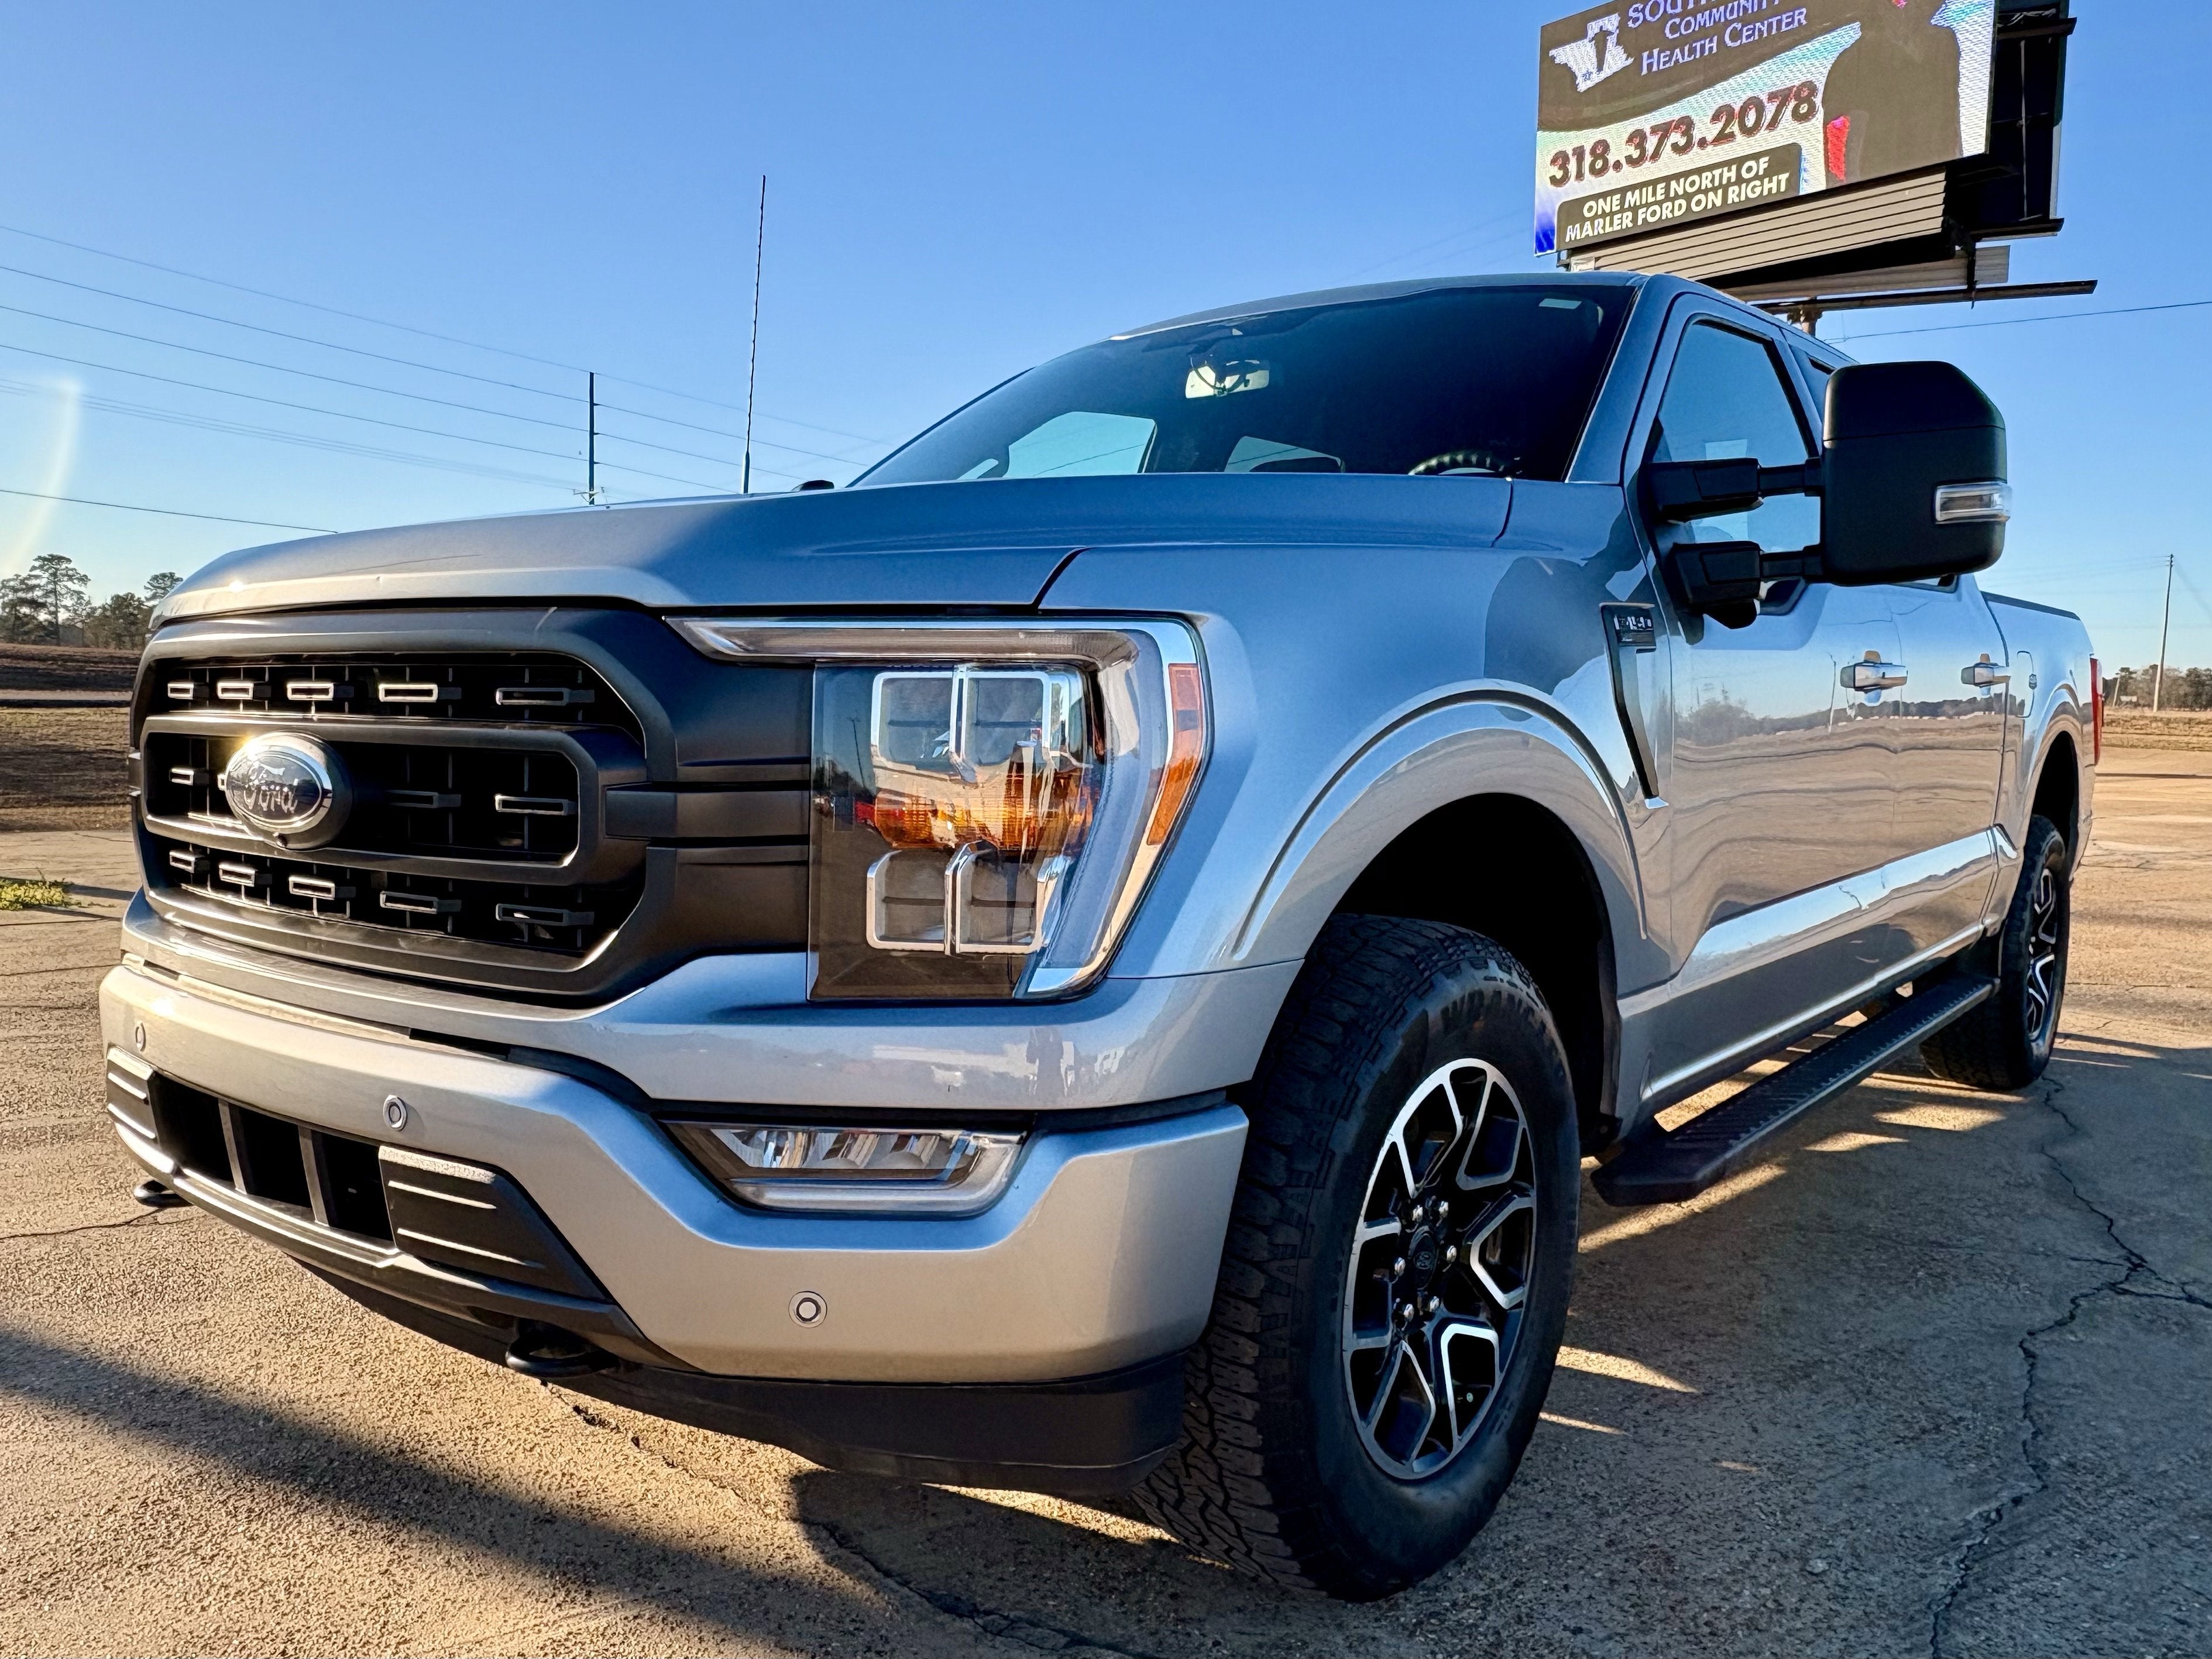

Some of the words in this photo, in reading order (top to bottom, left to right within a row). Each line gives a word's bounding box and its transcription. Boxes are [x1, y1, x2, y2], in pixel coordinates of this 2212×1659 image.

[1628, 0, 1716, 28] SOU
[1640, 35, 1719, 76] HEALTH
[1724, 8, 1808, 48] CENTER
[1549, 81, 1818, 188] 318.373.2078
[1565, 211, 1634, 243] MARLER
[1637, 197, 1688, 225] FORD
[1690, 188, 1723, 212] ON
[1727, 172, 1790, 204] RIGHT
[1582, 194, 1621, 218] ONE
[1624, 182, 1666, 208] MILE
[1669, 162, 1739, 197] NORTH
[1740, 156, 1770, 180] OF
[243, 761, 300, 813] Ford
